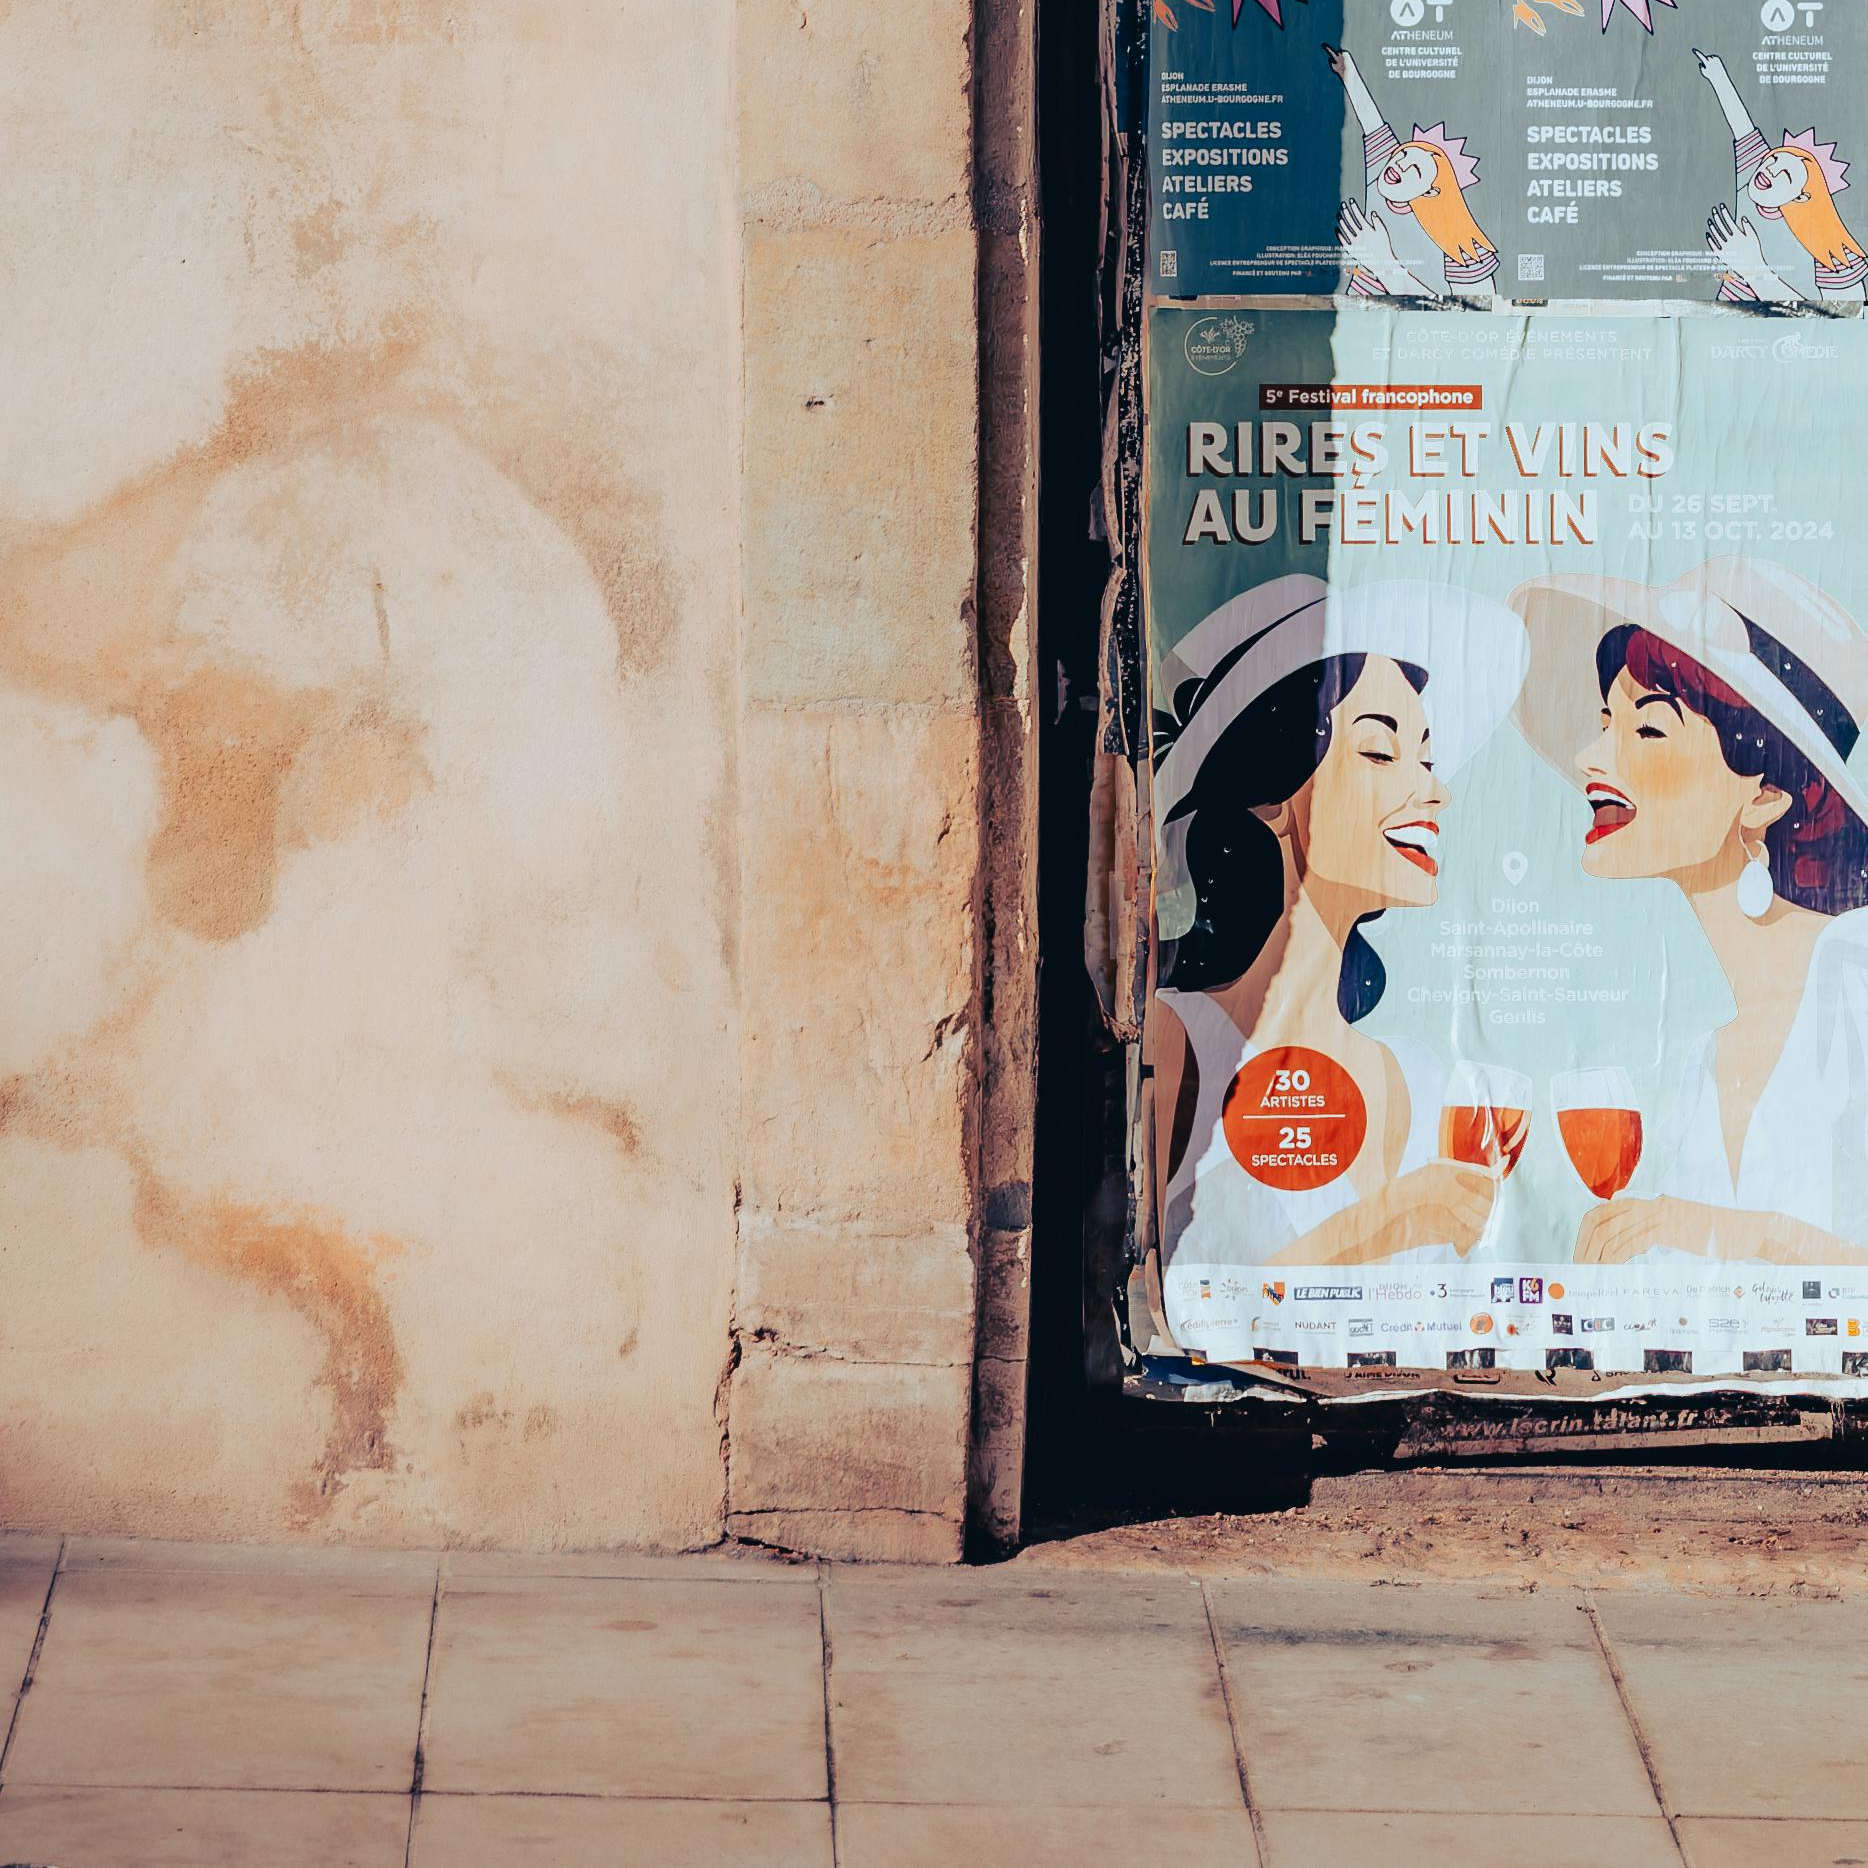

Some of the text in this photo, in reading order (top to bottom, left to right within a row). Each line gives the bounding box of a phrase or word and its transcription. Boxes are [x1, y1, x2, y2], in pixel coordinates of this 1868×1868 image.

[1761, 34, 1824, 46] ATHENEUM
[1753, 51, 1833, 62] CENTRE CULTUREL
[1527, 125, 1652, 145] SPECTACLES
[1527, 152, 1659, 171] EXPOSITIONS
[1527, 179, 1623, 198] ATELIERS
[1527, 199, 1579, 225] CAFÉ
[1288, 388, 1358, 406] Festival
[1361, 388, 1474, 409] francophone
[1187, 421, 1676, 479] RIRES ET VINS
[1184, 473, 1599, 546] AU FÉMININ
[1628, 494, 1778, 513] DU 26 SEPT.
[1628, 521, 1834, 540] AU 13 OCT. 2024
[1274, 1069, 1311, 1092] 30
[1260, 1094, 1326, 1108] ARTISTES
[1278, 1127, 1312, 1149] 25
[1251, 1152, 1338, 1167] SPECTACLES
